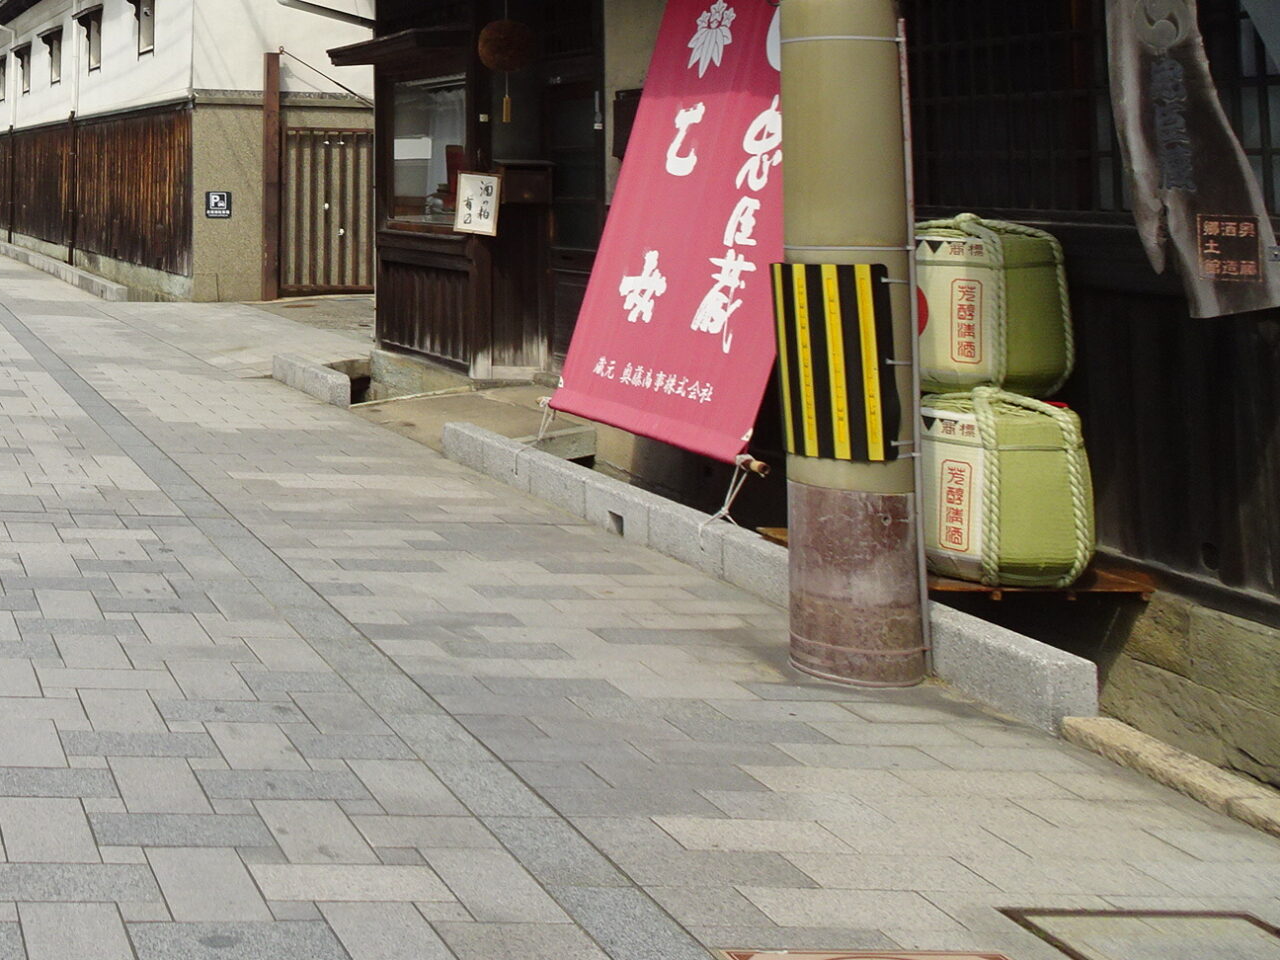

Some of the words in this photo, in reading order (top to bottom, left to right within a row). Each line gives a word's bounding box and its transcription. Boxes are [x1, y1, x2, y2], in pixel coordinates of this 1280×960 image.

[956, 283, 976, 359] 芳醇清酒
[945, 467, 966, 546] 芳醇清酒
